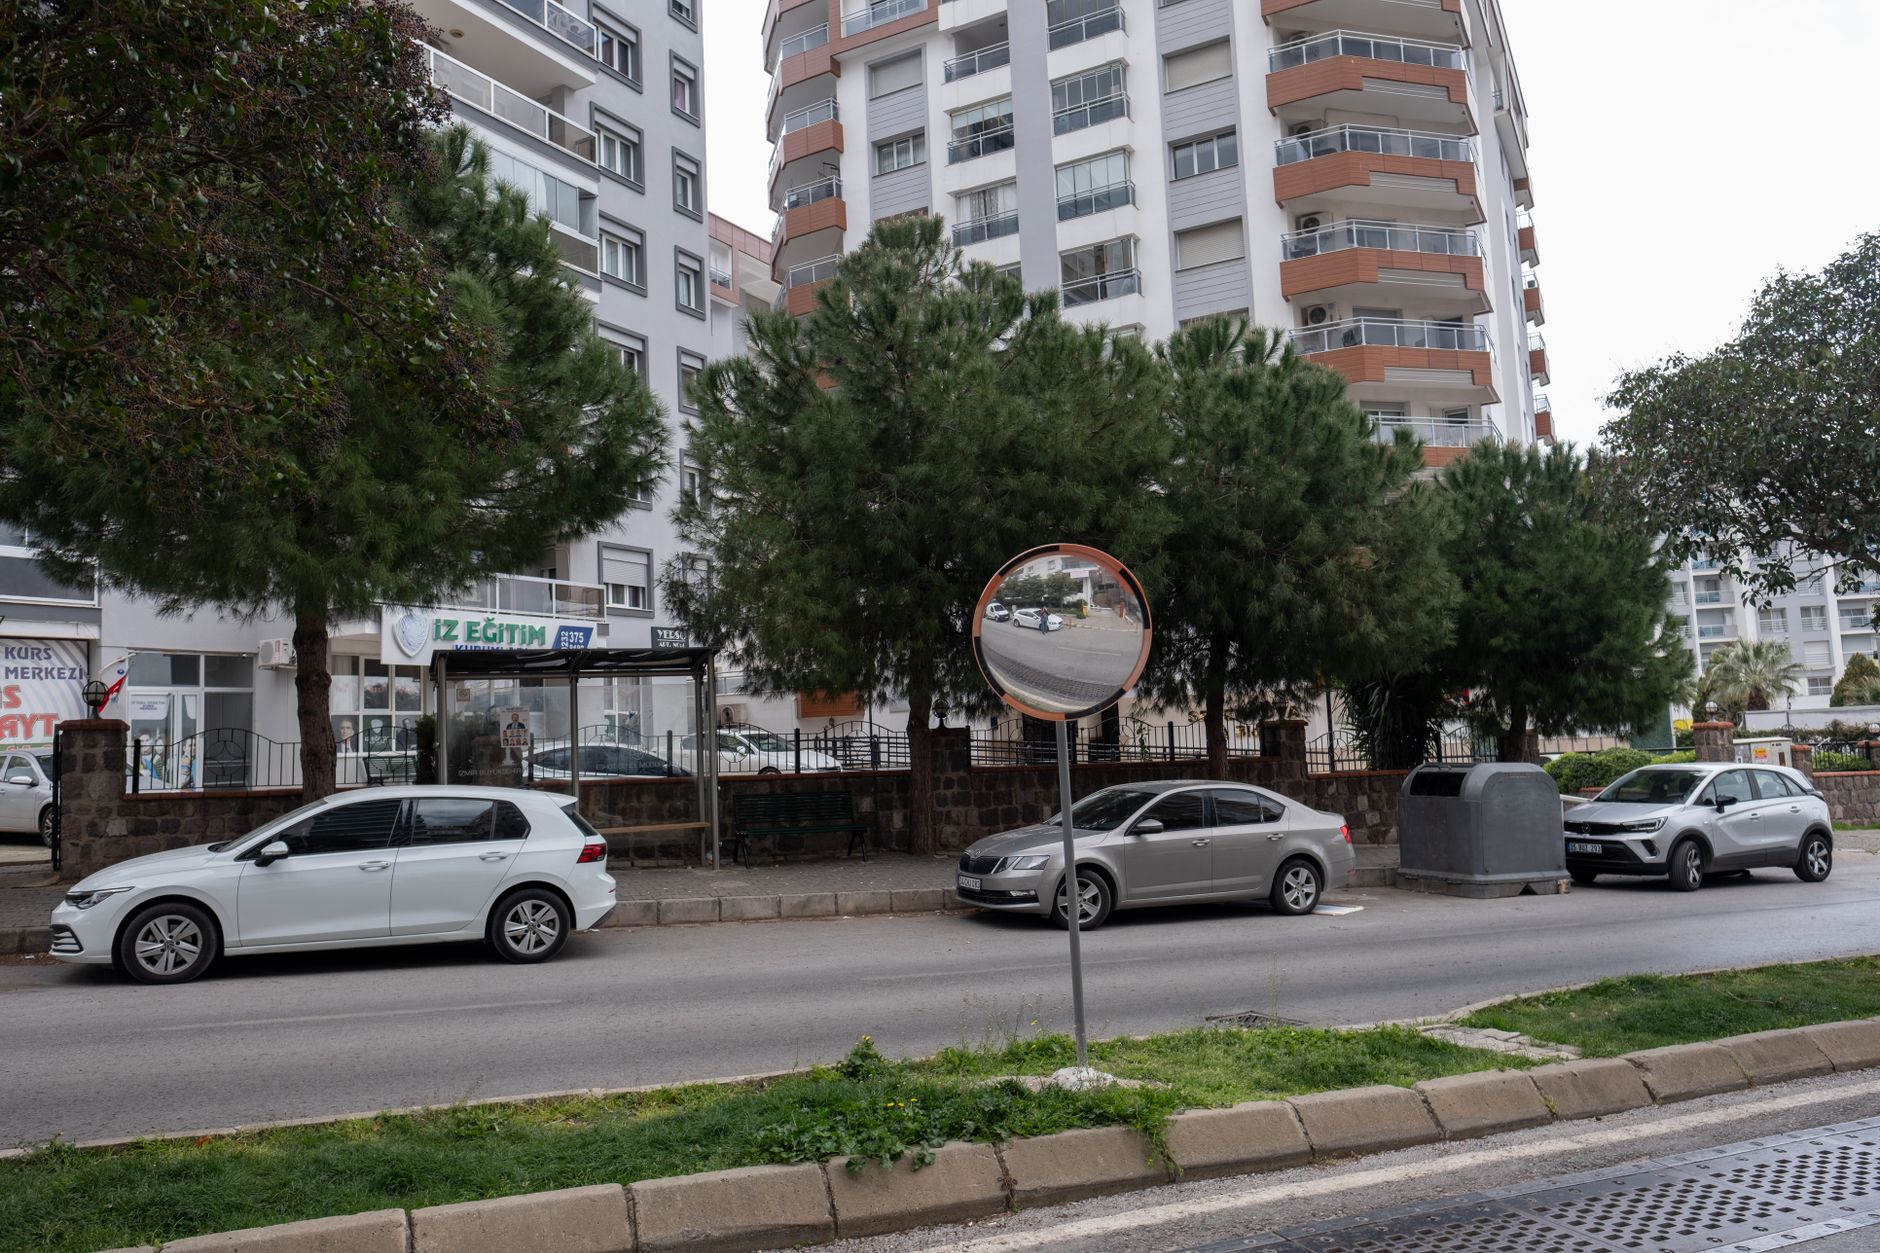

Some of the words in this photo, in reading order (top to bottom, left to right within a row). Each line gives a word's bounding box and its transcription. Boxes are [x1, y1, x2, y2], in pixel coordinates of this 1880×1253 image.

[561, 631, 569, 650] 232
[569, 631, 584, 643] 375
[4, 646, 52, 661] KURS
[4, 665, 84, 680] MERKEZİ
